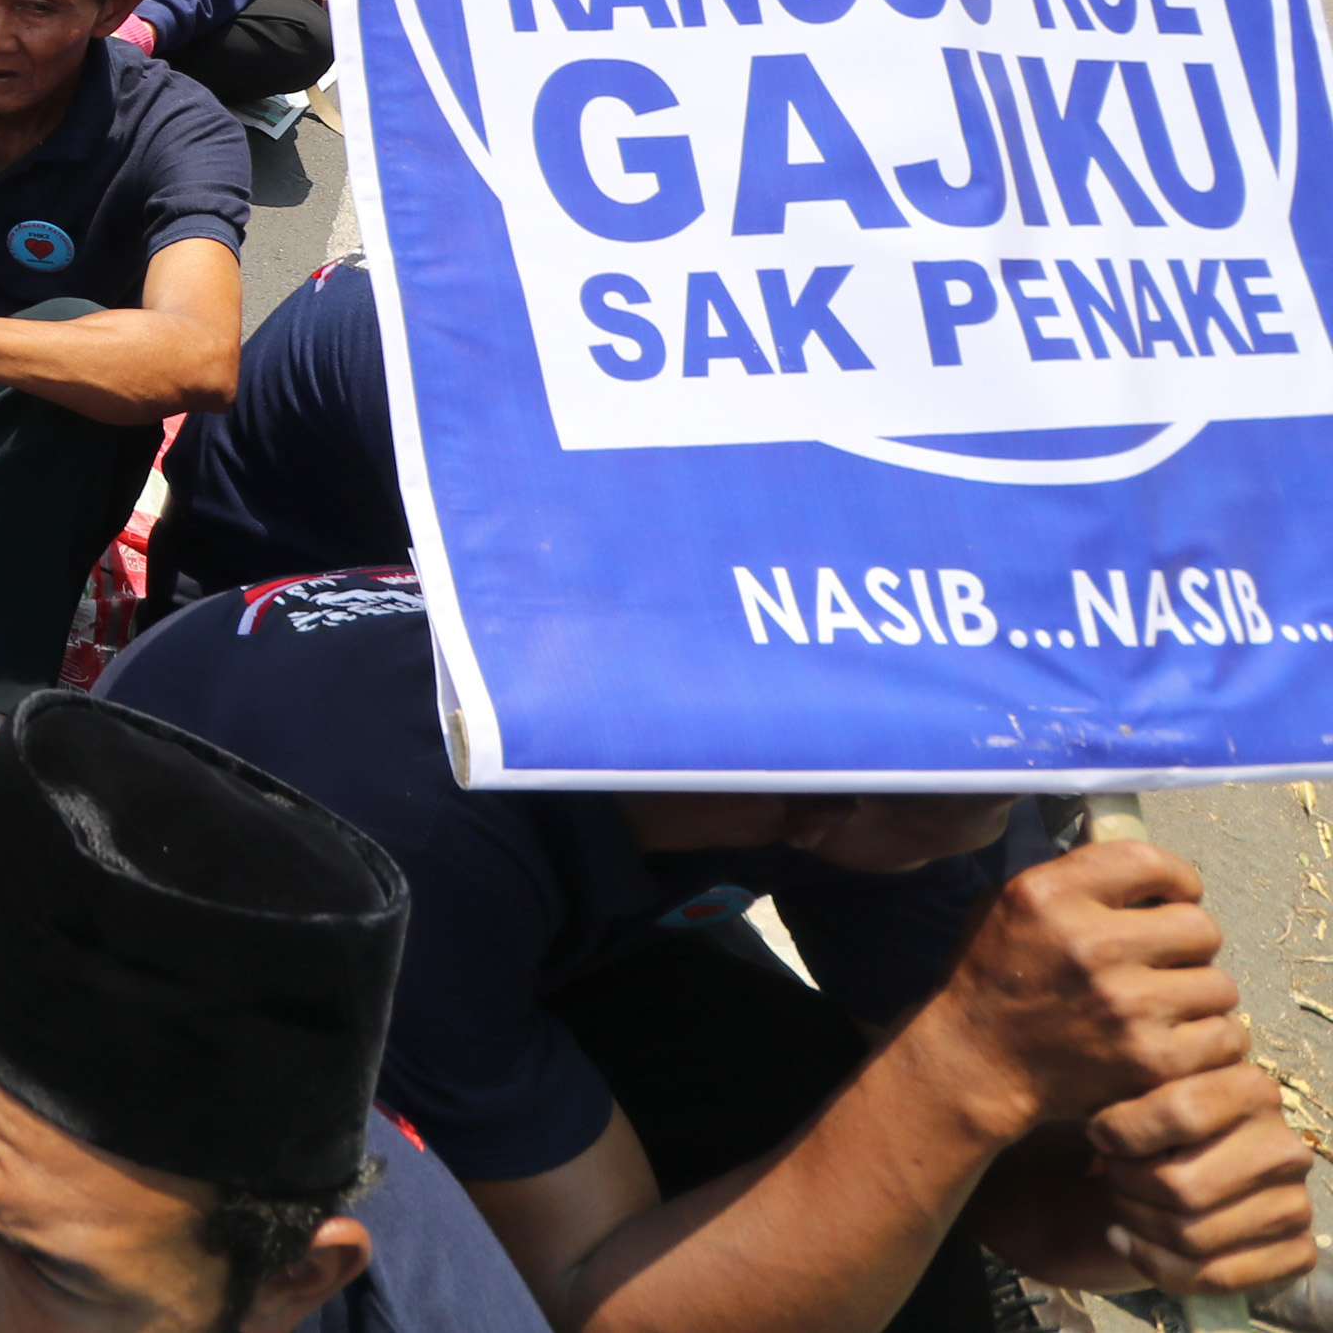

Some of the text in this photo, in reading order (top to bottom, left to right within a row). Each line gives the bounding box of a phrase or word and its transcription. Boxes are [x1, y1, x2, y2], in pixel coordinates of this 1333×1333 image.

[532, 50, 1246, 243] GAJIKU
[579, 258, 1299, 382] SAK PENAKE
